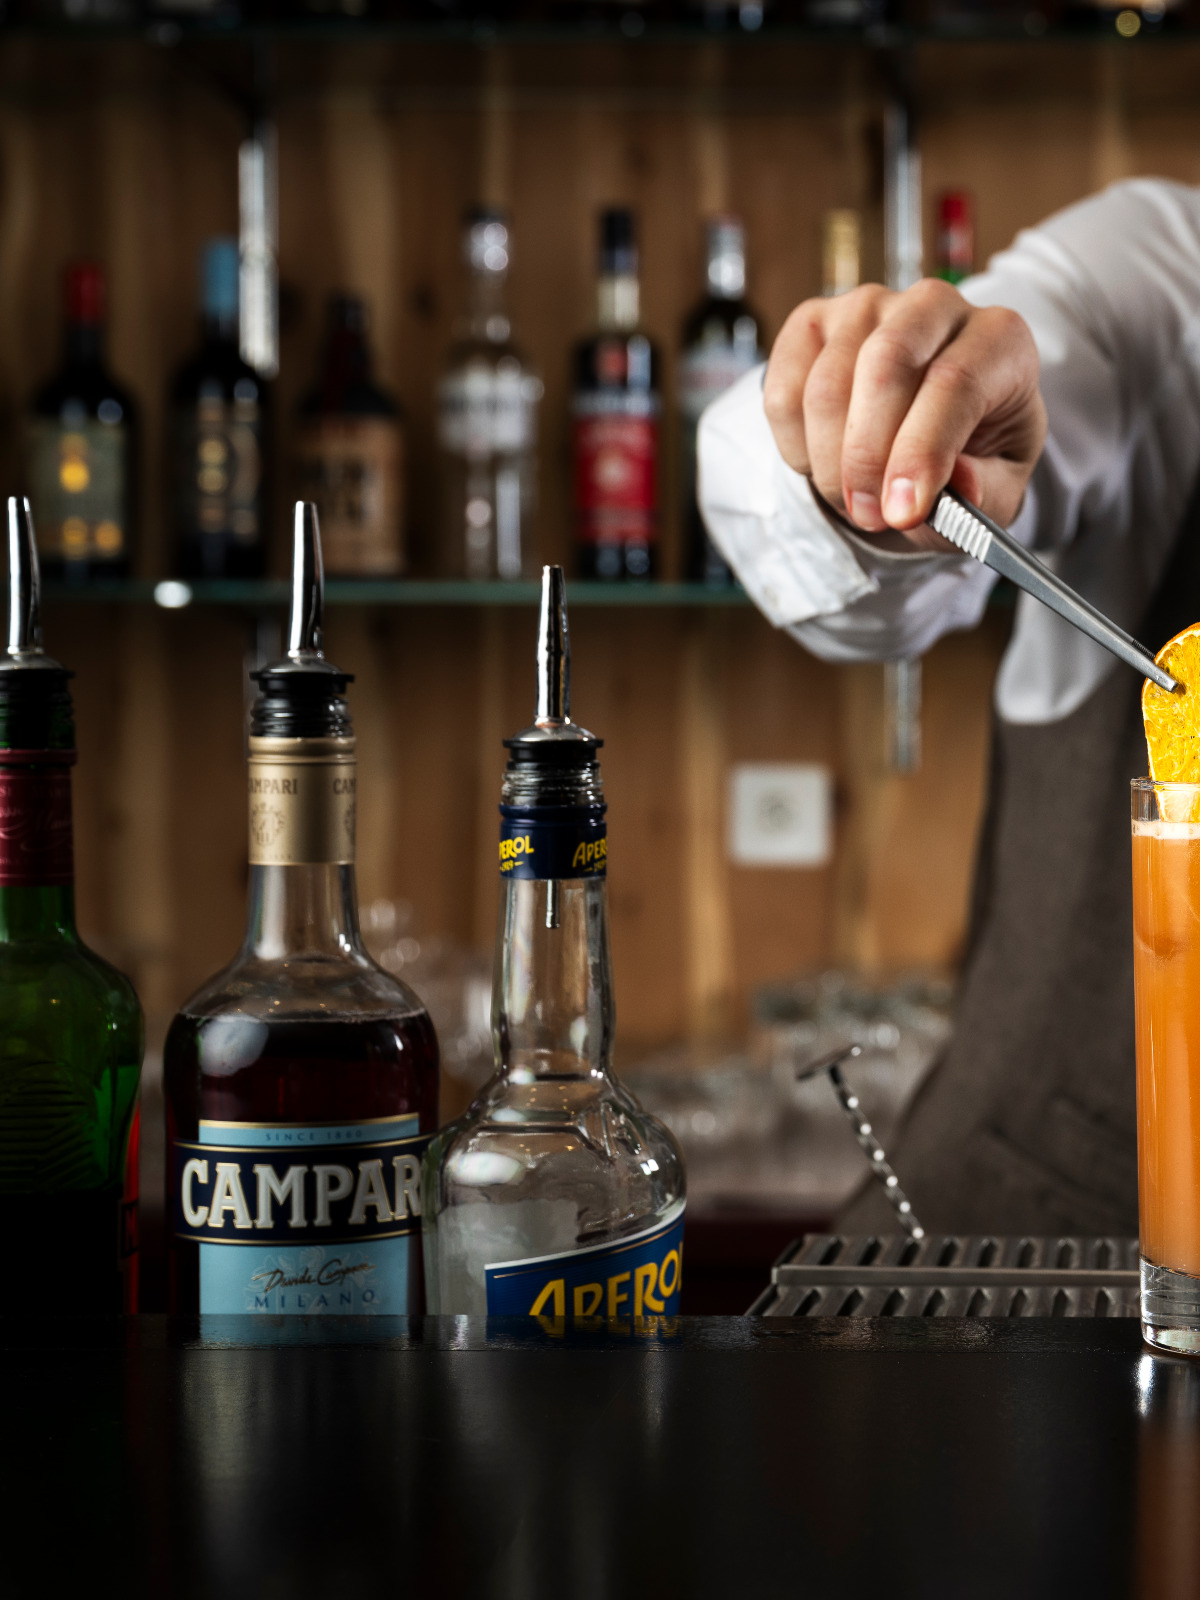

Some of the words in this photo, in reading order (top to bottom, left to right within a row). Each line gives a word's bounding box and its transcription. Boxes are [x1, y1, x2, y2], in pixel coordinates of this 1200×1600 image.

[265, 1131, 315, 1142] SINCE
[327, 1129, 363, 1140] 1860
[182, 1154, 421, 1229] CAMPAR
[254, 1289, 375, 1308] MILANO
